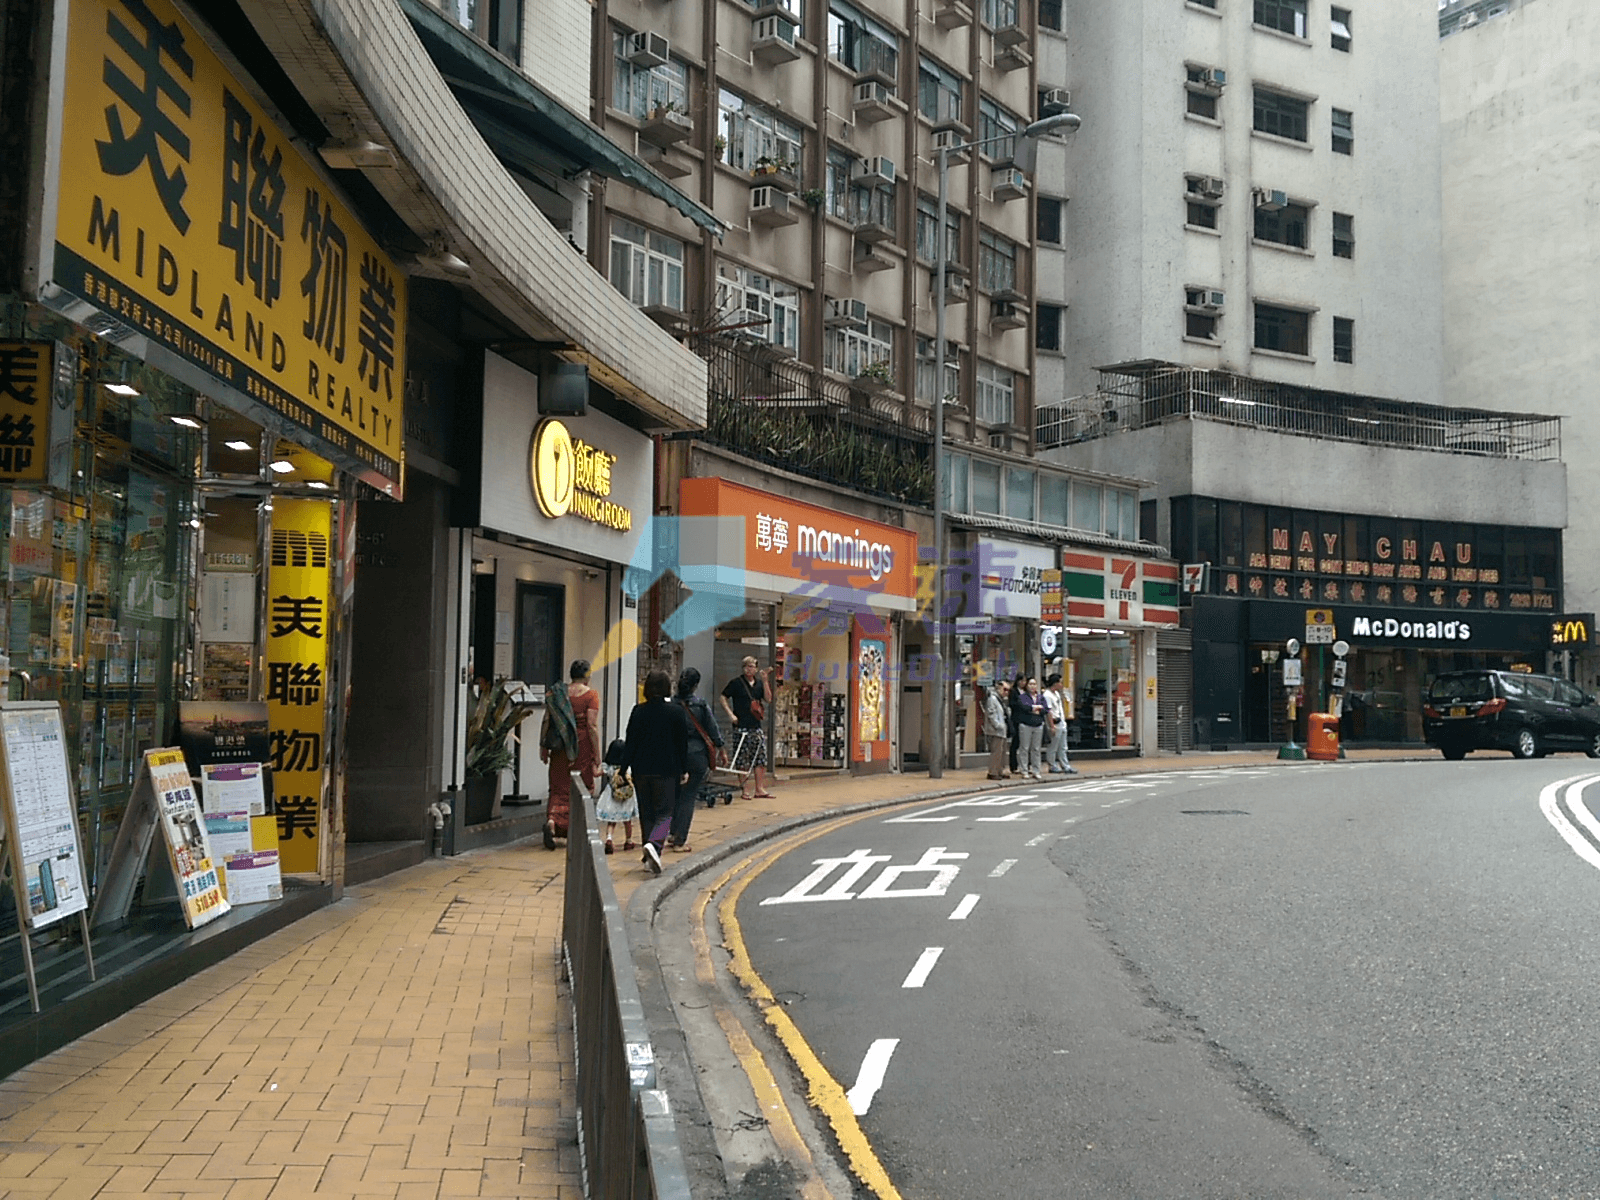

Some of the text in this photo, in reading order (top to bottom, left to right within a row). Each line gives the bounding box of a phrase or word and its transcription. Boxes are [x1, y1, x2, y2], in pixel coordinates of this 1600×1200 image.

[95, 0, 396, 401] 美聯物業
[87, 195, 393, 446] MIDLAND REALTY
[756, 512, 788, 554] 萬寧
[797, 524, 892, 581] mannings
[1272, 528, 1471, 564] MAY CHAU
[1427, 566, 1447, 580] AND
[1352, 617, 1470, 640] McDonald's
[267, 595, 324, 842] 美聯物業
[759, 846, 970, 906] 站
